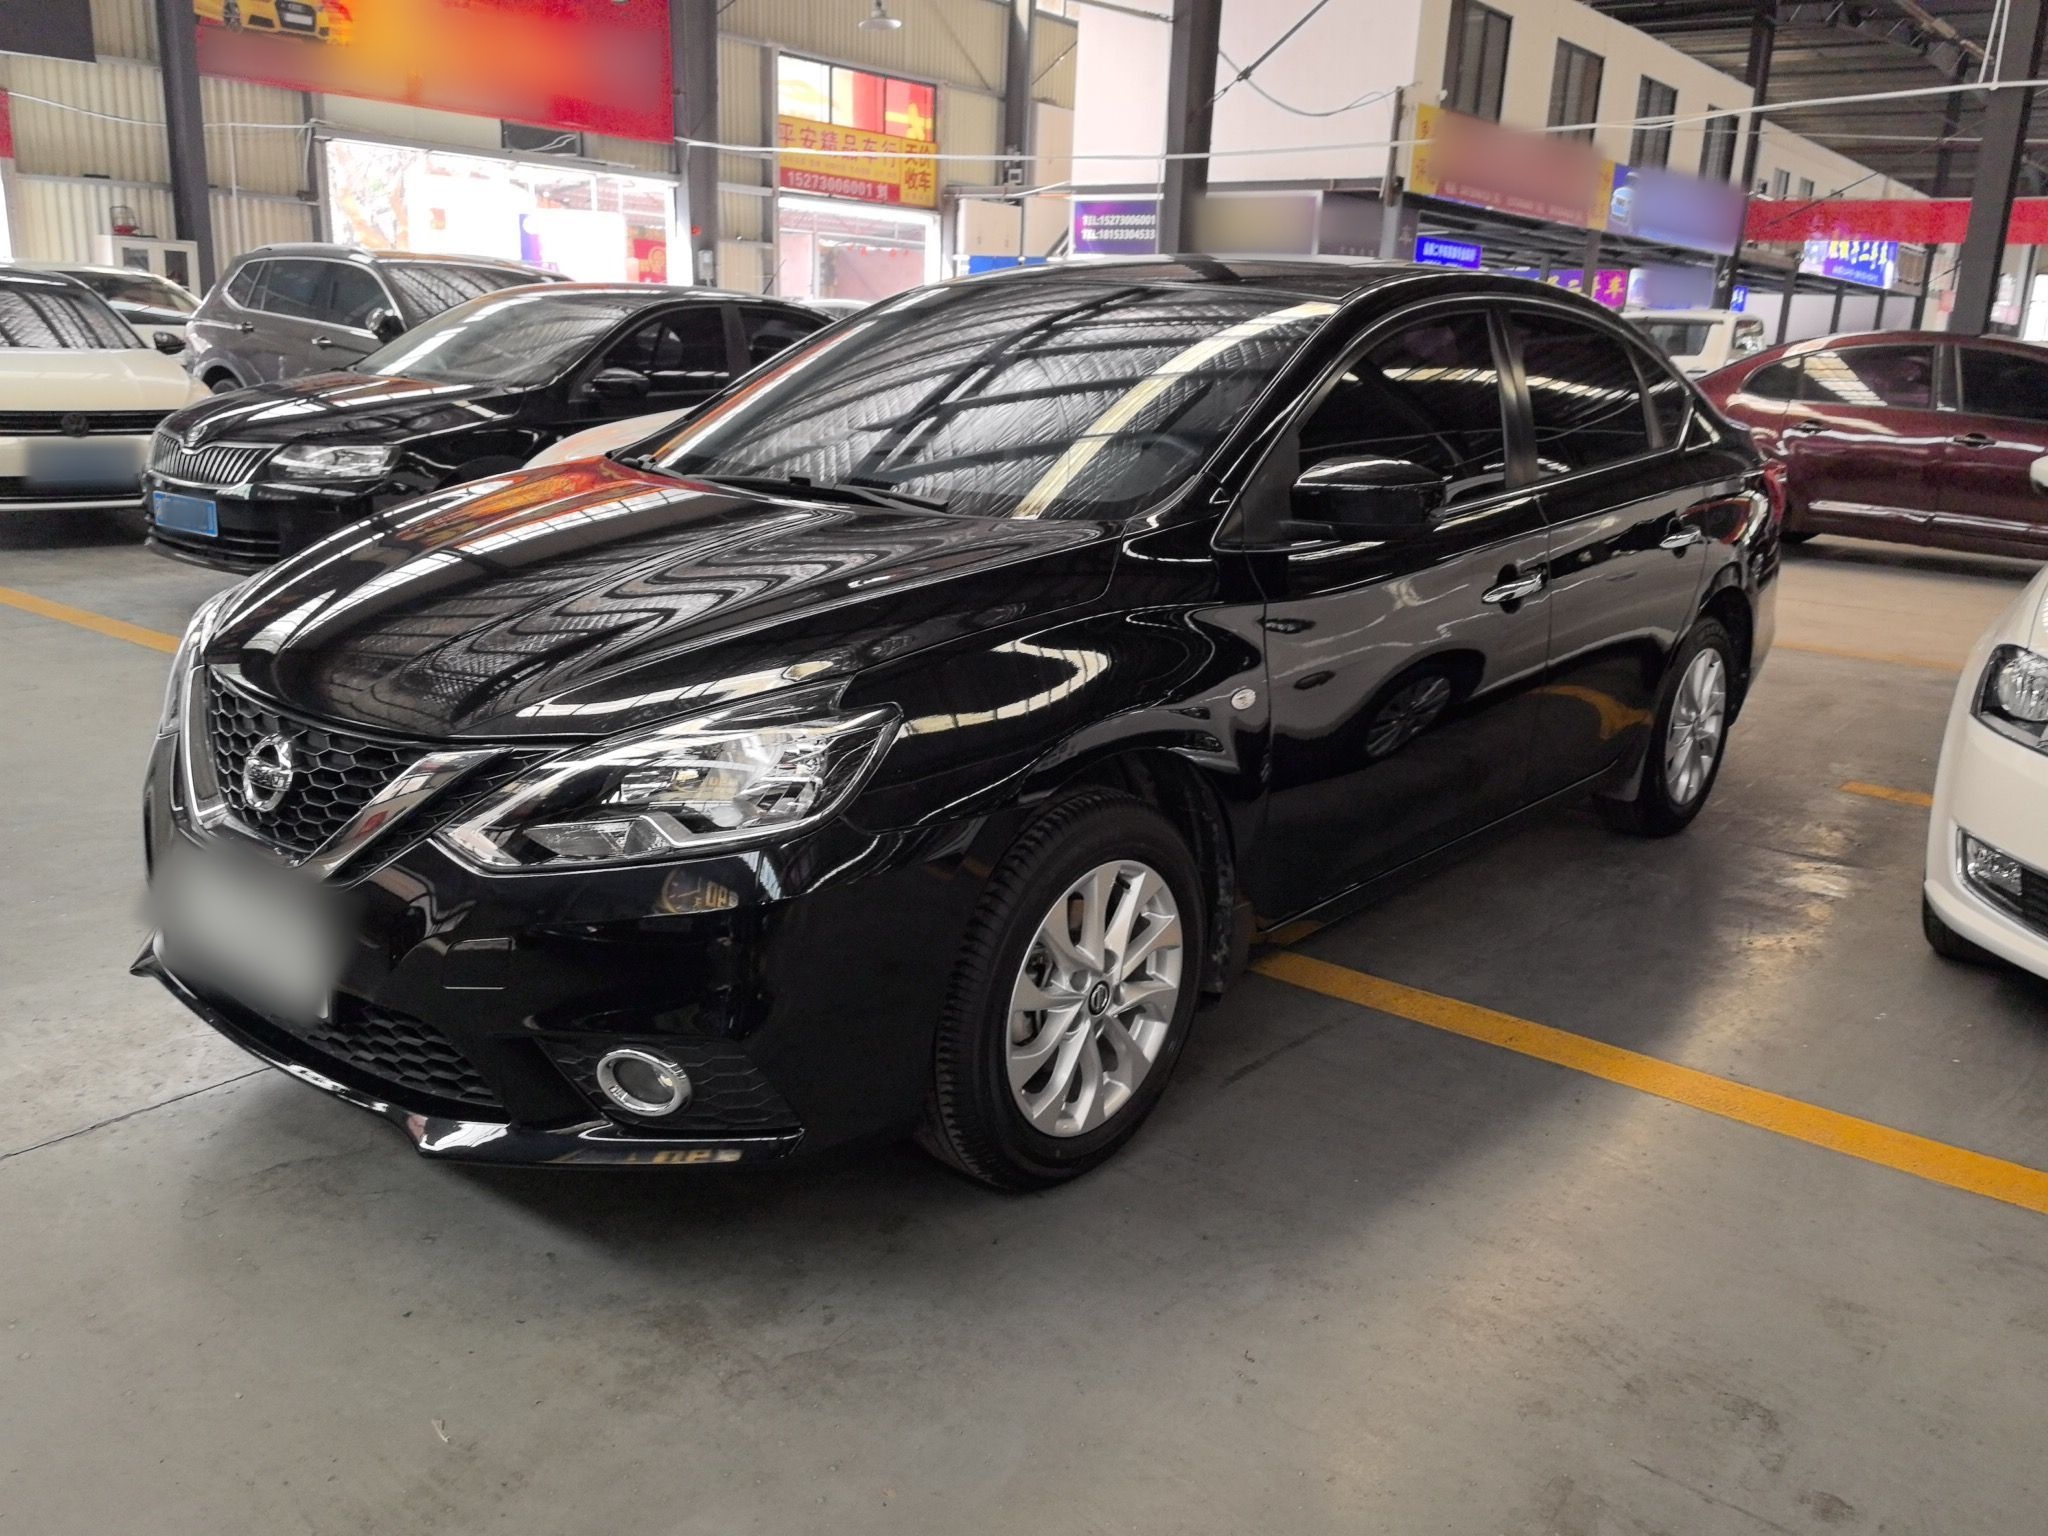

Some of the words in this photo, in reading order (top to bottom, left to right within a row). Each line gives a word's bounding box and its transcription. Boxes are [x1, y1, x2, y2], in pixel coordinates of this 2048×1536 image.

[778, 121, 896, 168] 平安精品车行
[787, 171, 873, 196] 15273006001
